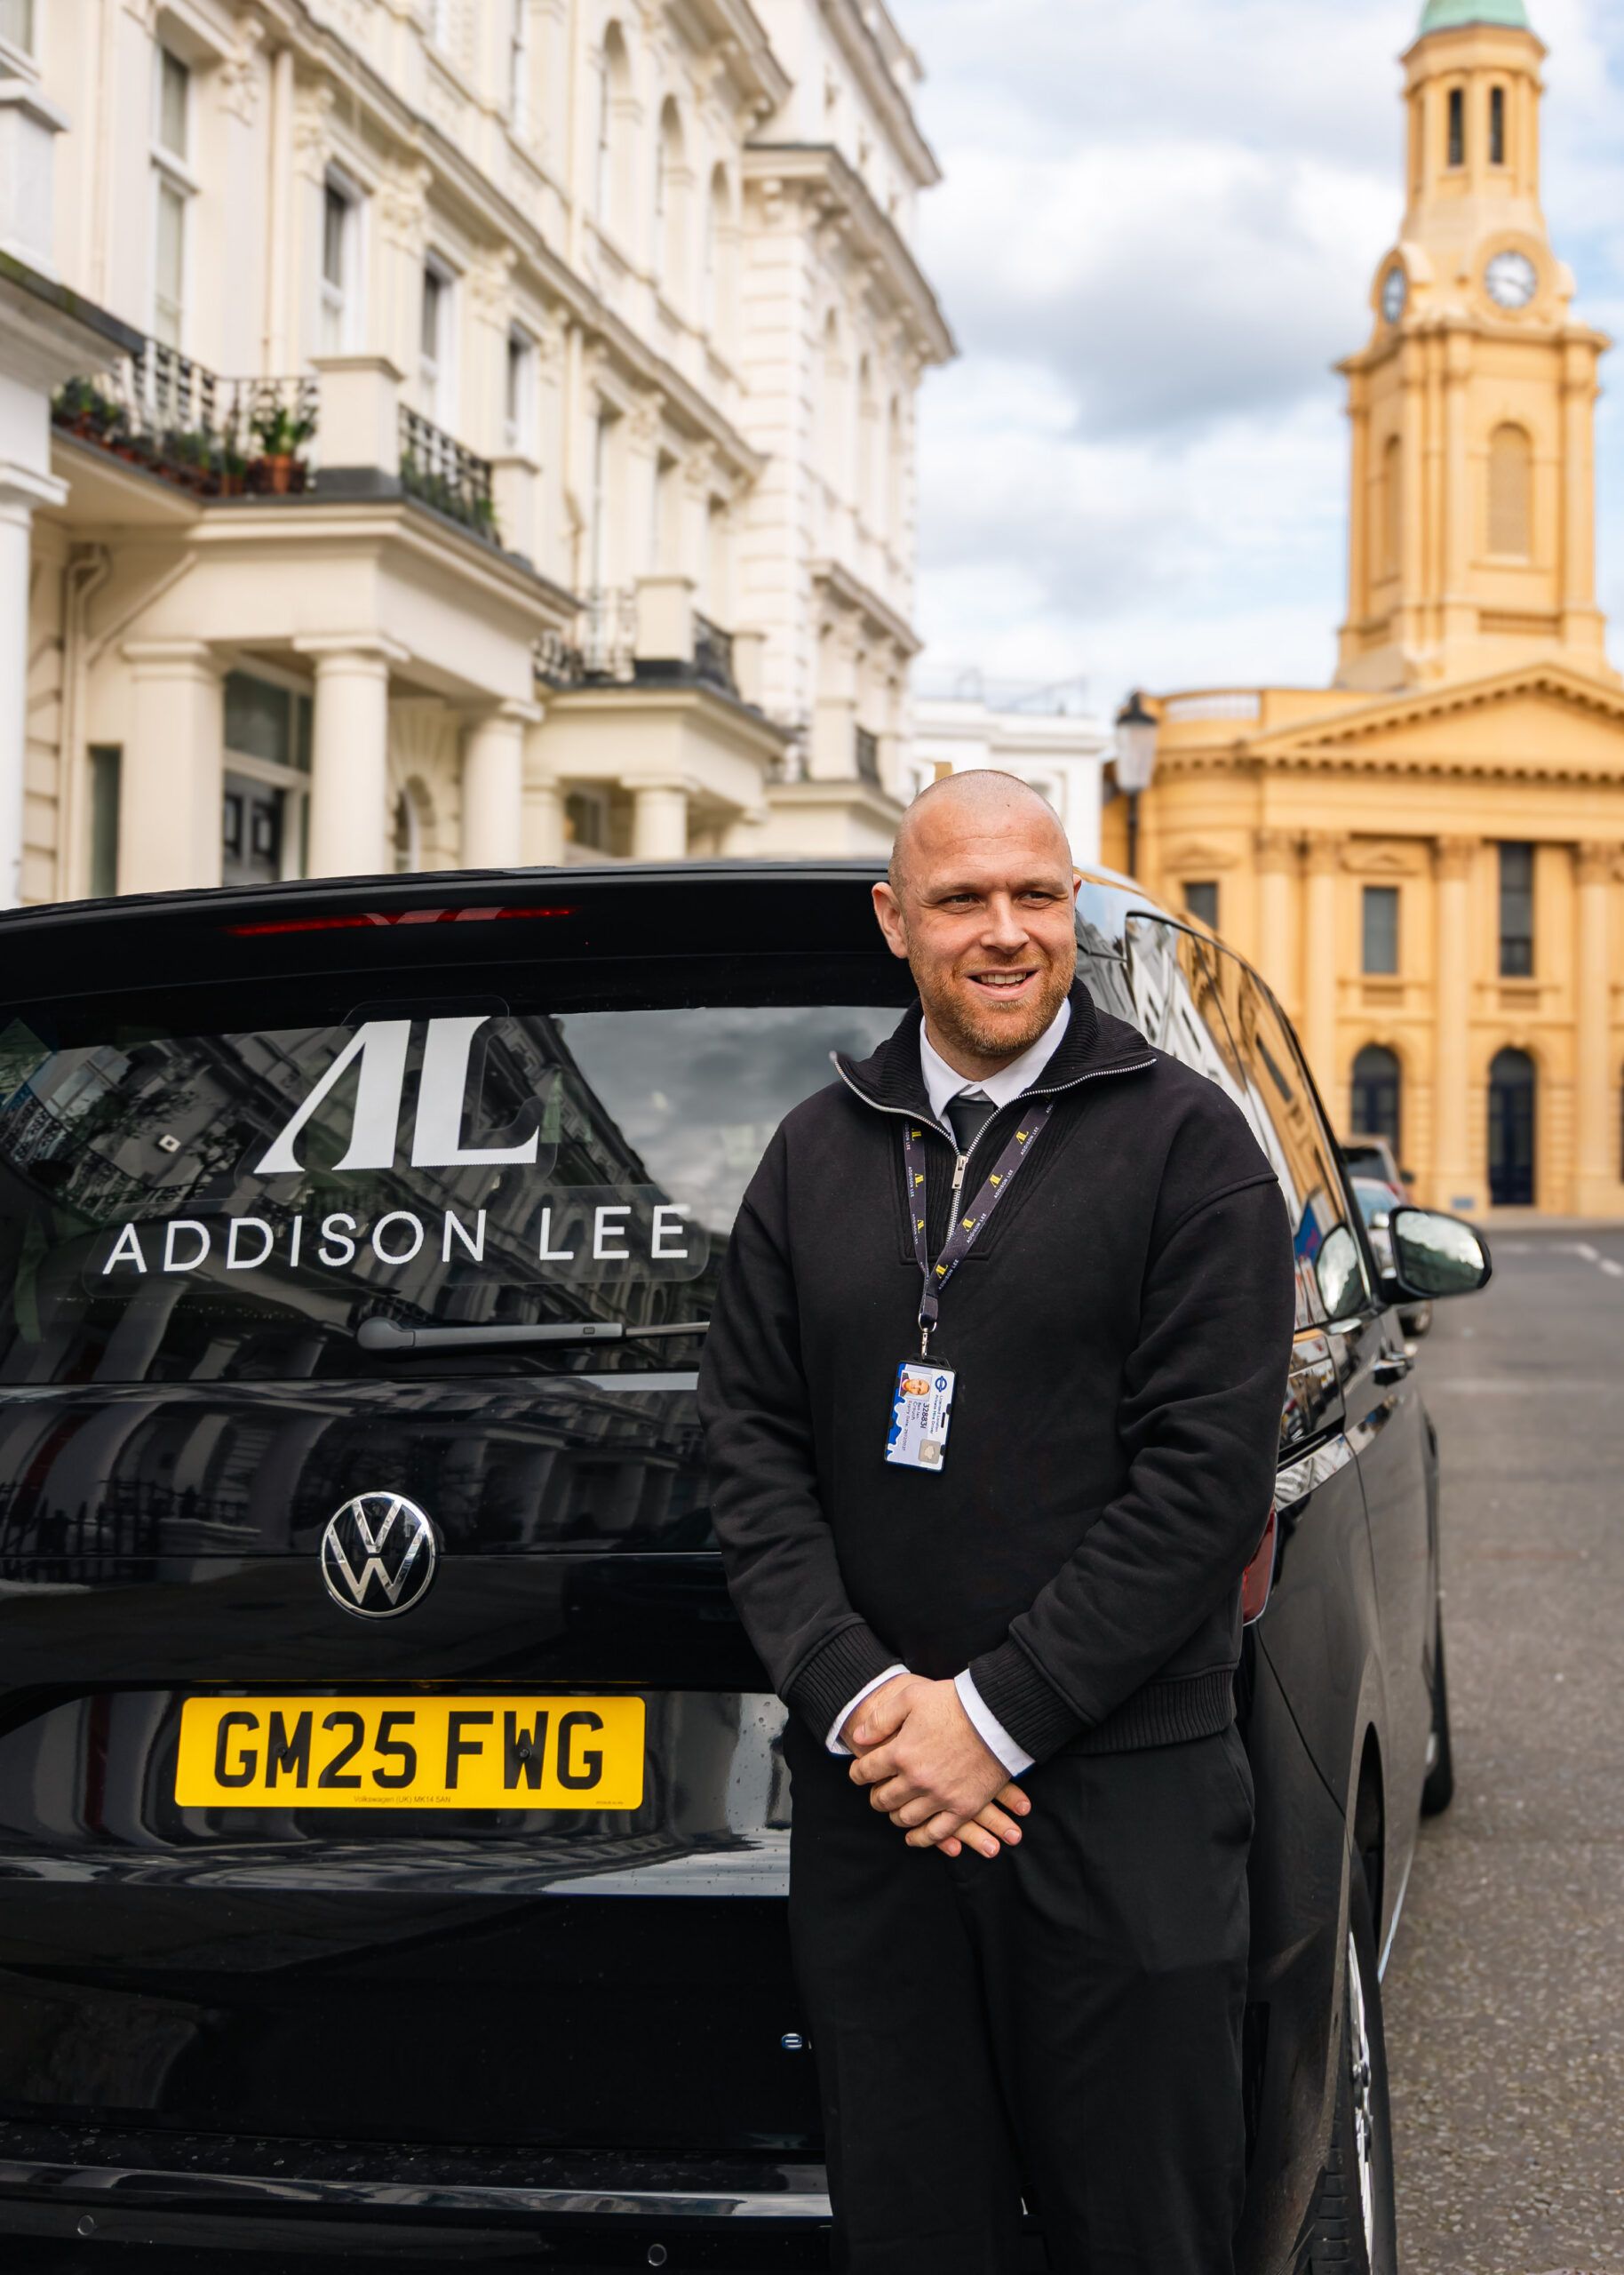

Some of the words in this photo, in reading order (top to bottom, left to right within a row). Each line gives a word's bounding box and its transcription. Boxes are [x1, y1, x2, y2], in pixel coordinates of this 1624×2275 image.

[1021, 1136, 1034, 1155] ADDISON
[994, 1178, 1008, 1199] ADDISON
[102, 1209, 487, 1274] ADDISON
[538, 1204, 692, 1261] LEE
[967, 1222, 981, 1243] ADDISON
[938, 1269, 953, 1289] ADDISON
[920, 1402, 929, 1429] 328831
[214, 1711, 418, 1788] GM25
[444, 1711, 604, 1790] FWG
[354, 1795, 394, 1804] Volkswagen
[396, 1795, 412, 1804] (UK)
